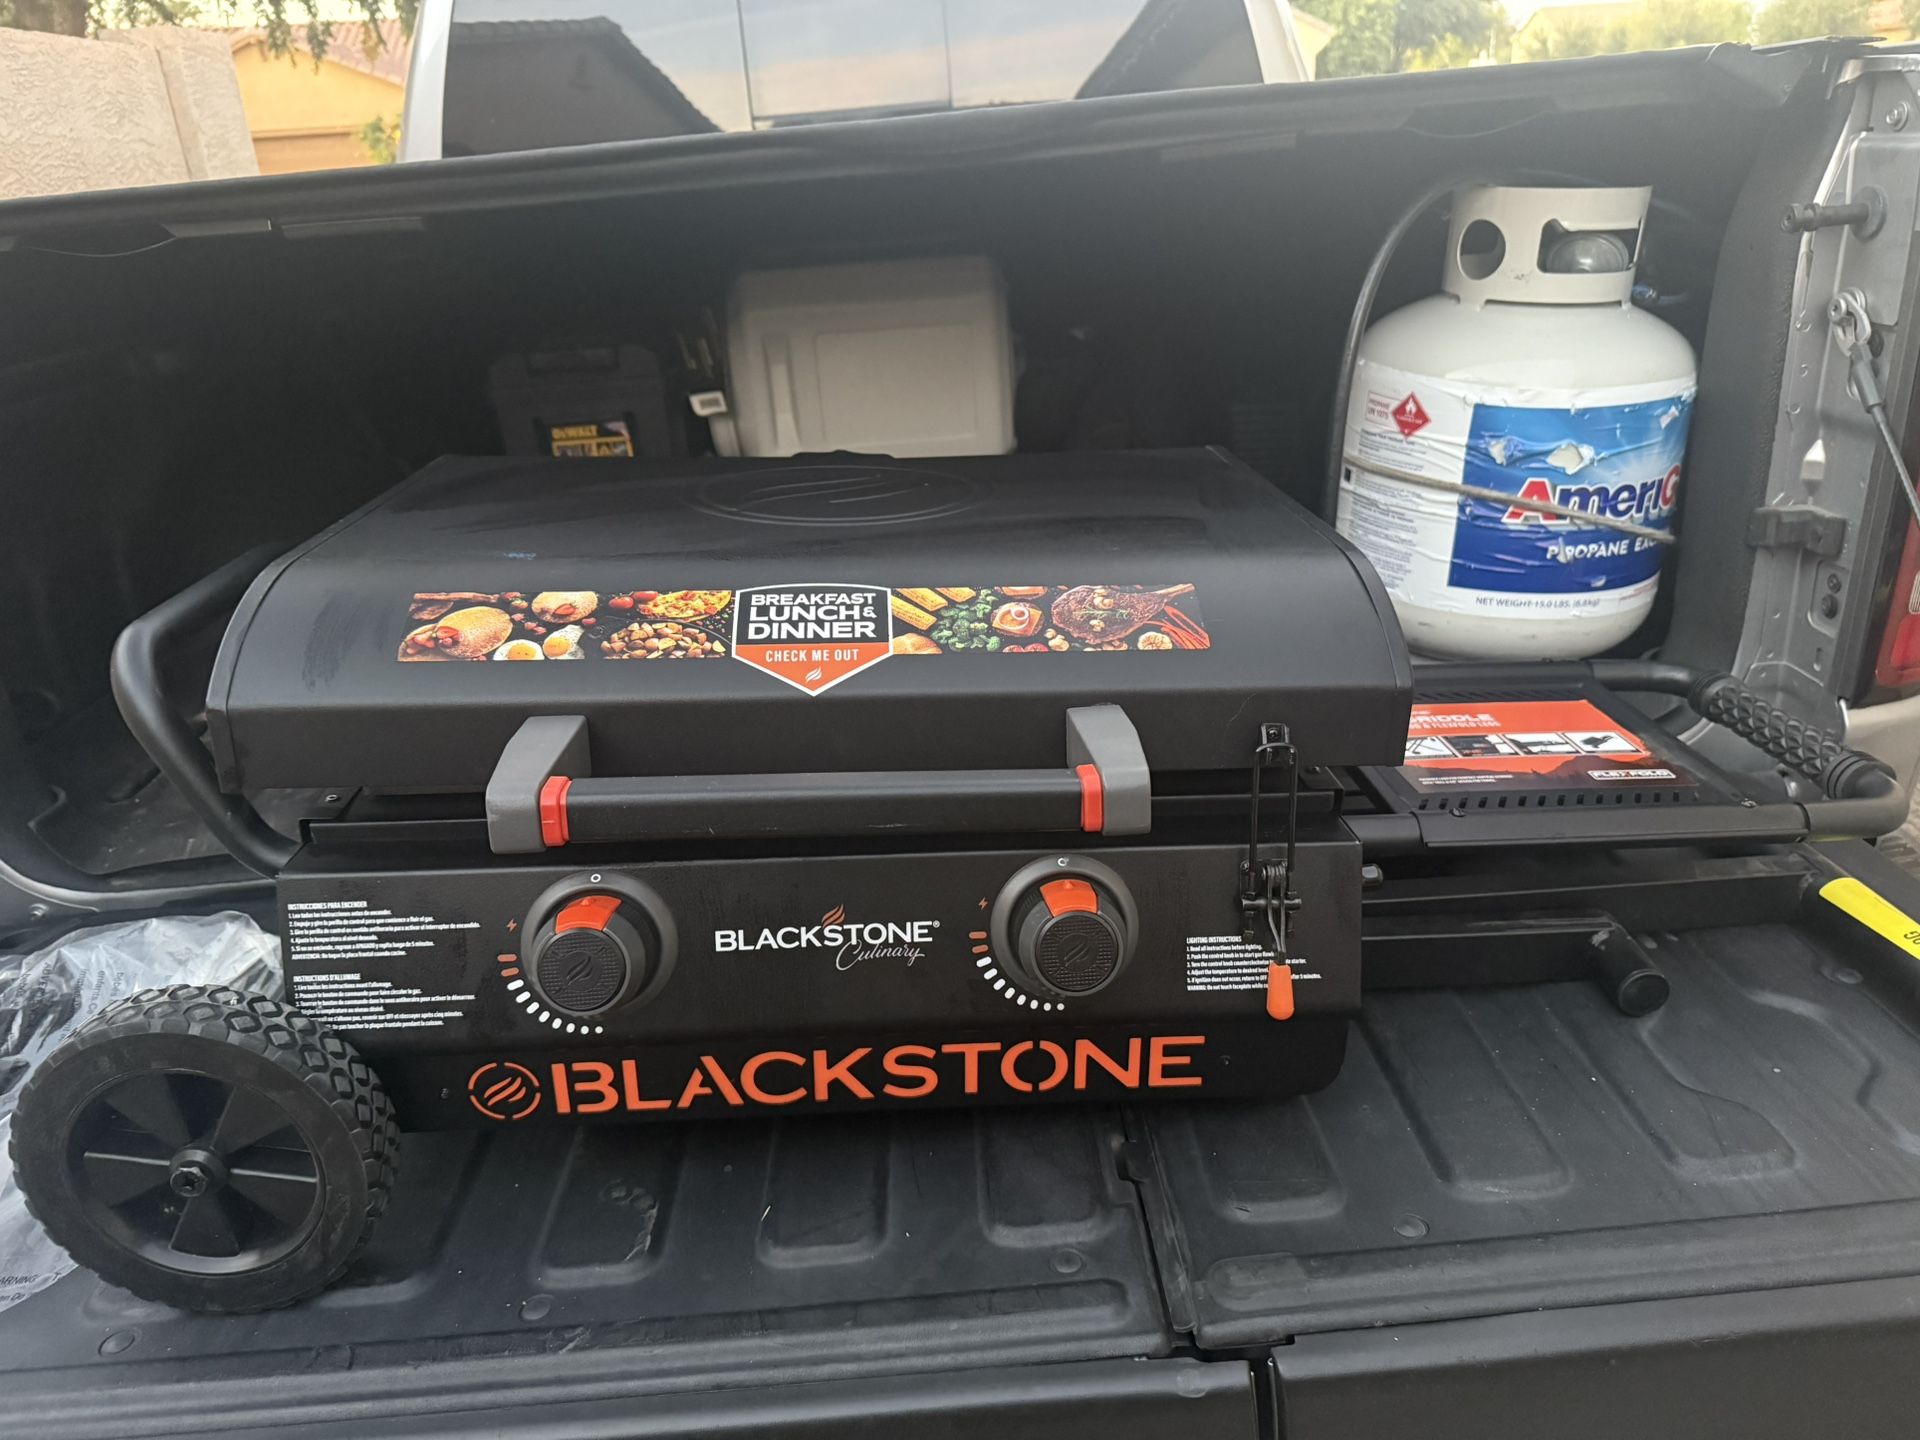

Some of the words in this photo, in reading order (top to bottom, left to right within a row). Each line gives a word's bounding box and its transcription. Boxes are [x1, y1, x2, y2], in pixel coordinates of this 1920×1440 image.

[751, 592, 877, 606] BREAKFAST
[1475, 597, 1493, 605] NET
[749, 605, 860, 622] LUNCH
[862, 606, 877, 619] &
[748, 621, 877, 640] DINNER
[765, 650, 807, 663] CHECK
[812, 649, 830, 662] ME
[834, 648, 859, 661] OUT
[836, 939, 925, 971] Culinary
[551, 1035, 1206, 1114] BLACKSTONE
